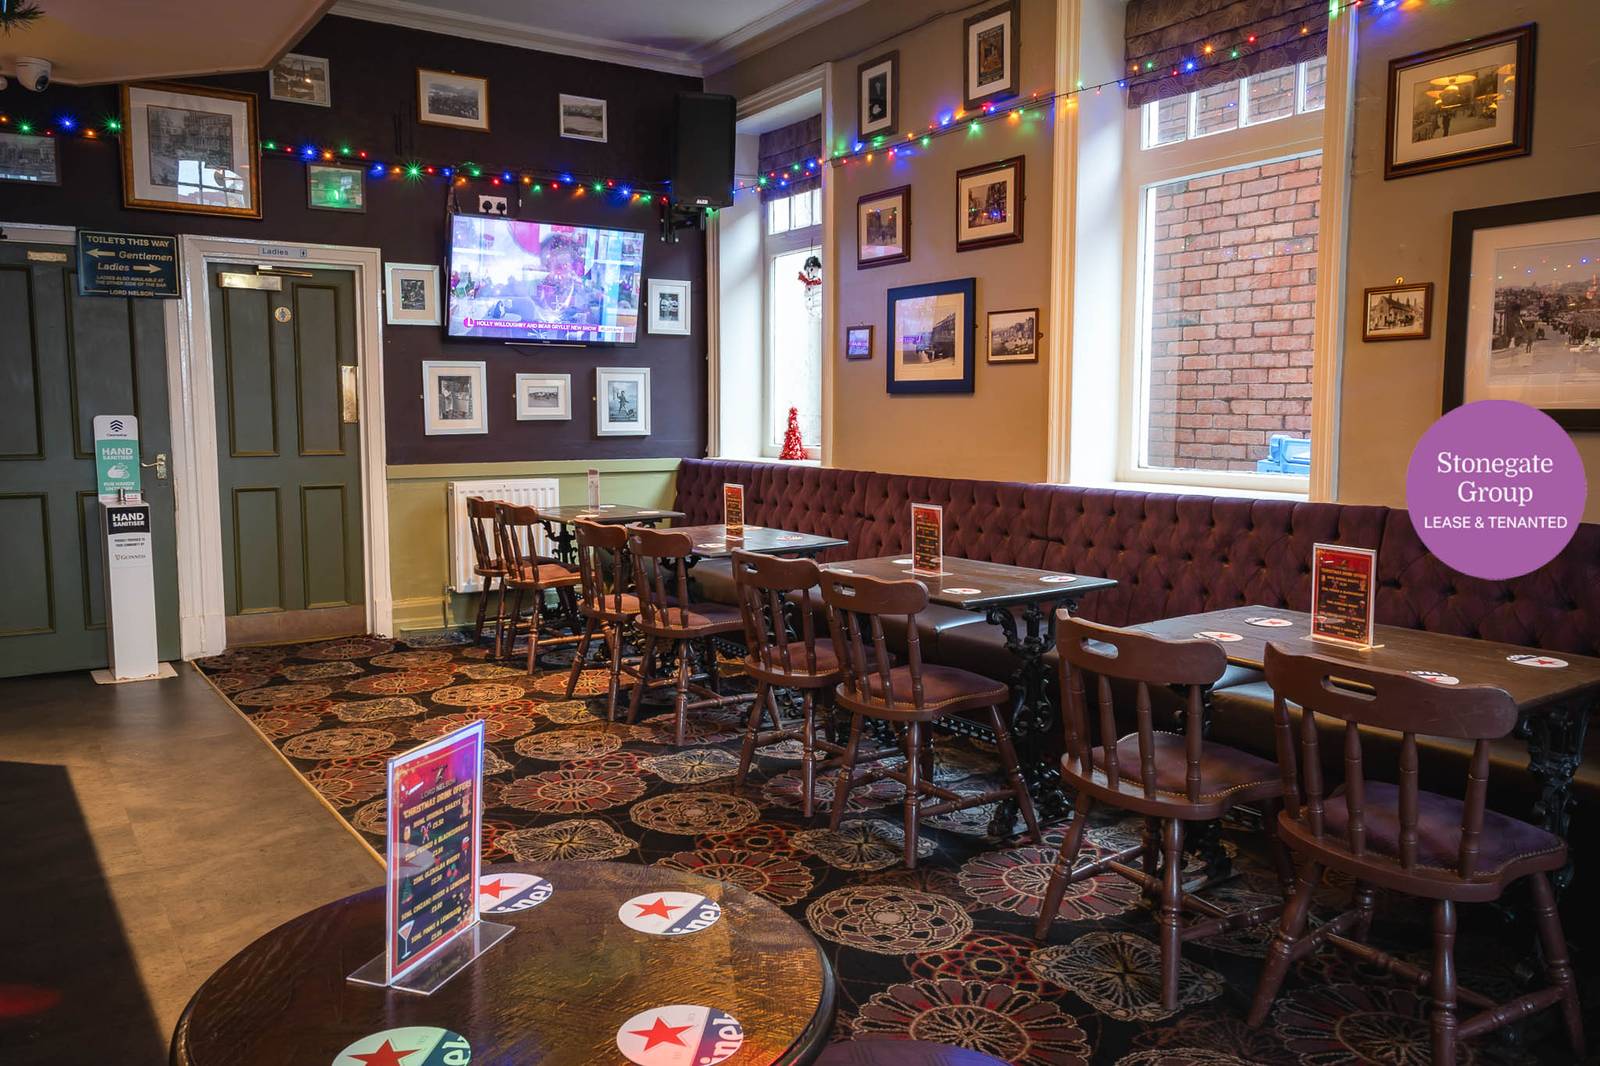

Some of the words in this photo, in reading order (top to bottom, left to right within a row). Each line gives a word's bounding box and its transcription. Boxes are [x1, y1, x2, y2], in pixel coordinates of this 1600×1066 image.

[87, 235, 126, 245] TOILETS
[151, 240, 169, 248] WAY
[119, 251, 172, 261] Gentlemen
[98, 263, 130, 271] Ladies
[112, 512, 145, 522] HAND
[403, 797, 436, 818] CHRISTMAS
